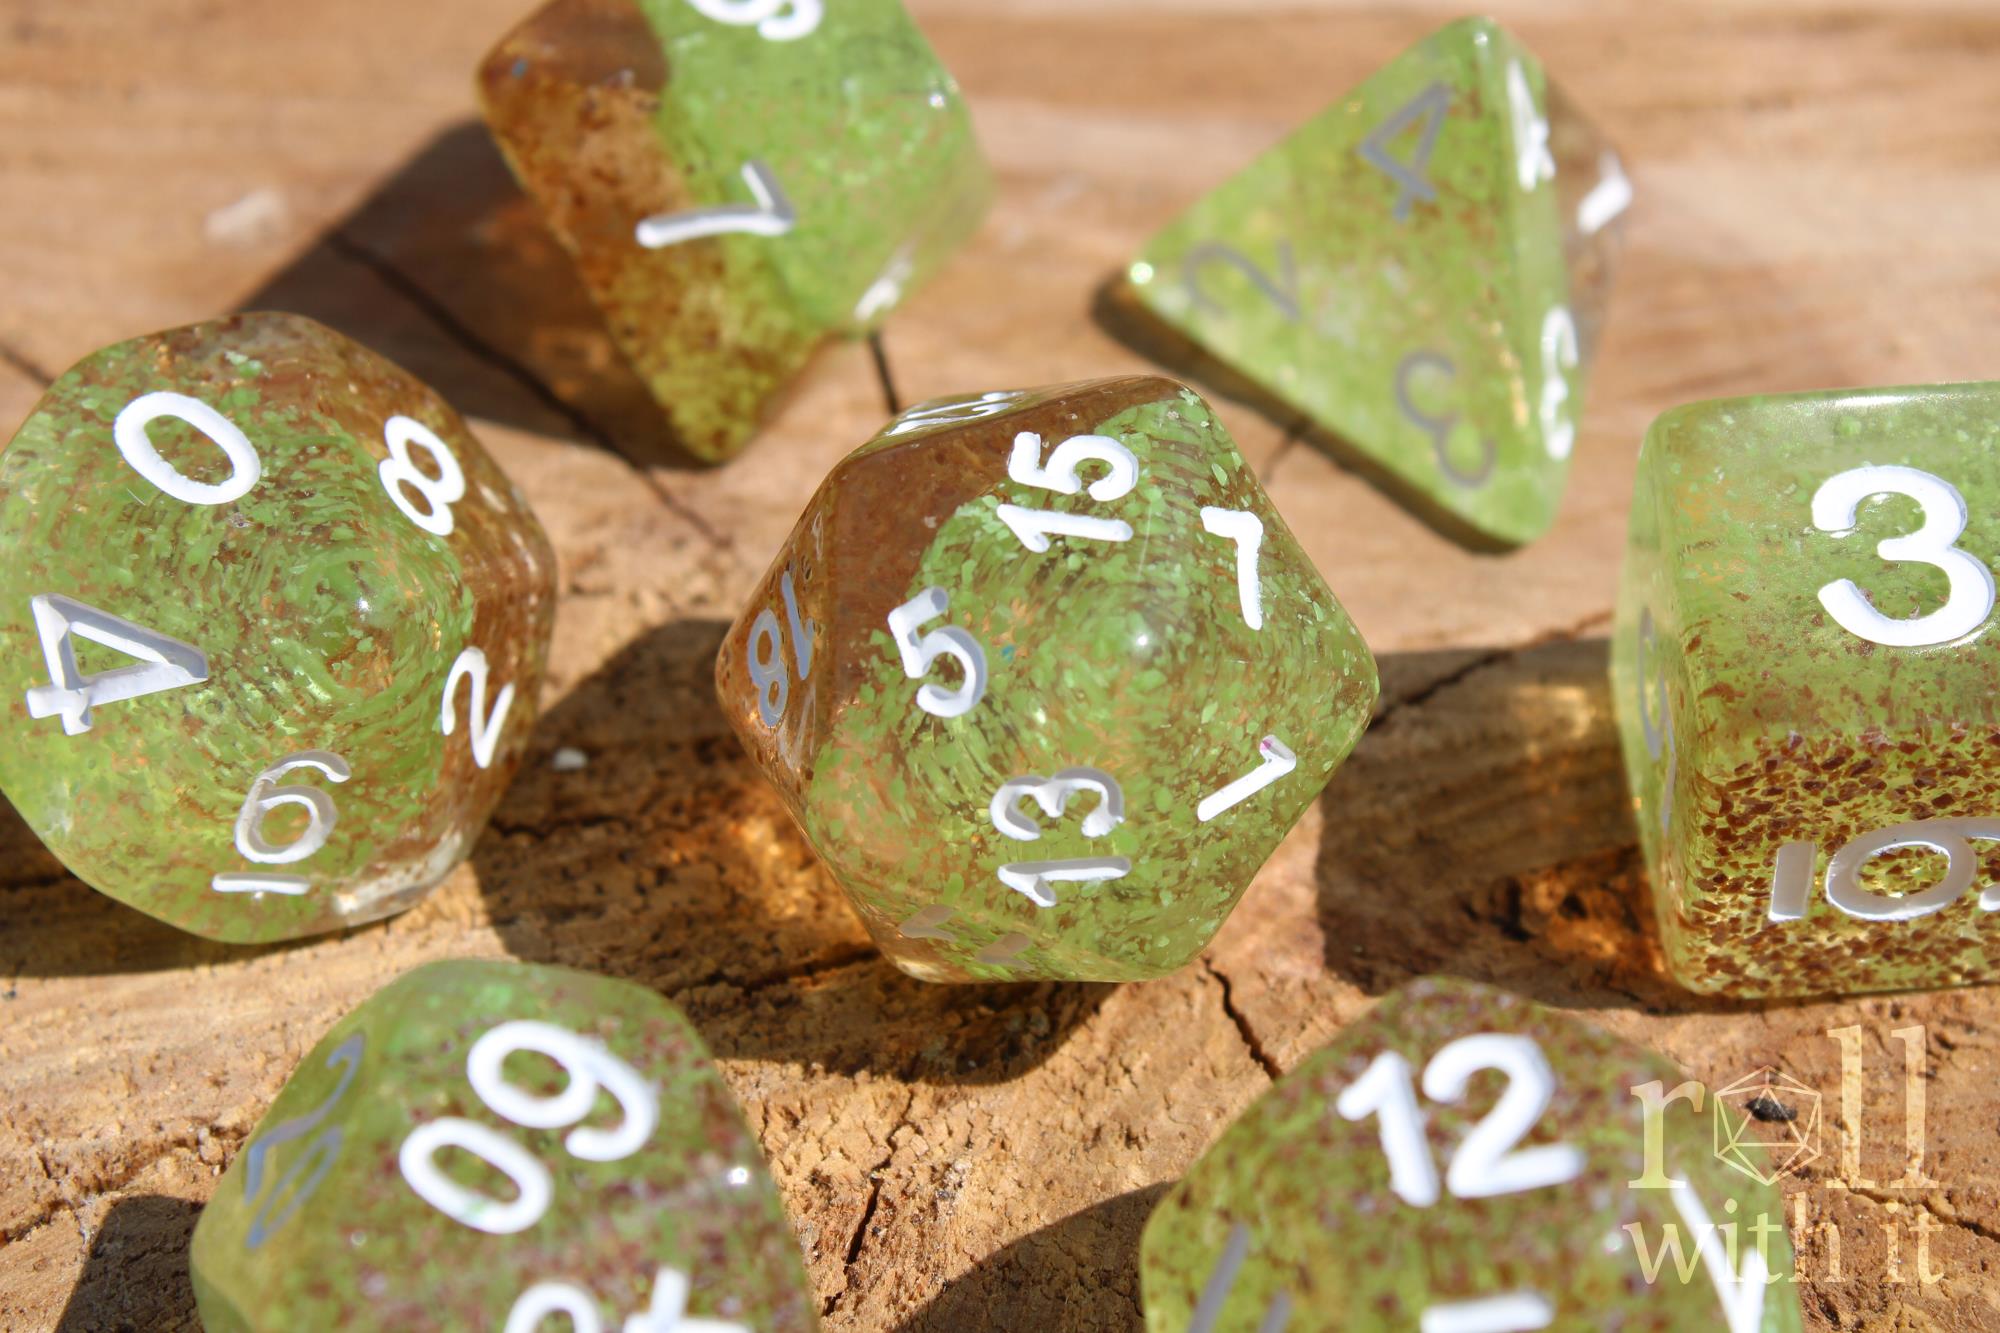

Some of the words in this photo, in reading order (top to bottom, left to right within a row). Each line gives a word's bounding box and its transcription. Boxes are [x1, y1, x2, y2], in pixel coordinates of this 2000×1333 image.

[1357, 80, 1453, 221] 4
[113, 391, 261, 505] 0
[378, 415, 466, 536] 8
[997, 430, 1139, 553] 15
[1199, 506, 1264, 631] 7
[1811, 464, 1996, 647] 3
[26, 592, 209, 736] 4
[441, 646, 516, 769] 2
[888, 585, 988, 718] 5
[989, 765, 1132, 907] 13
[1336, 1031, 1587, 1208] 12
